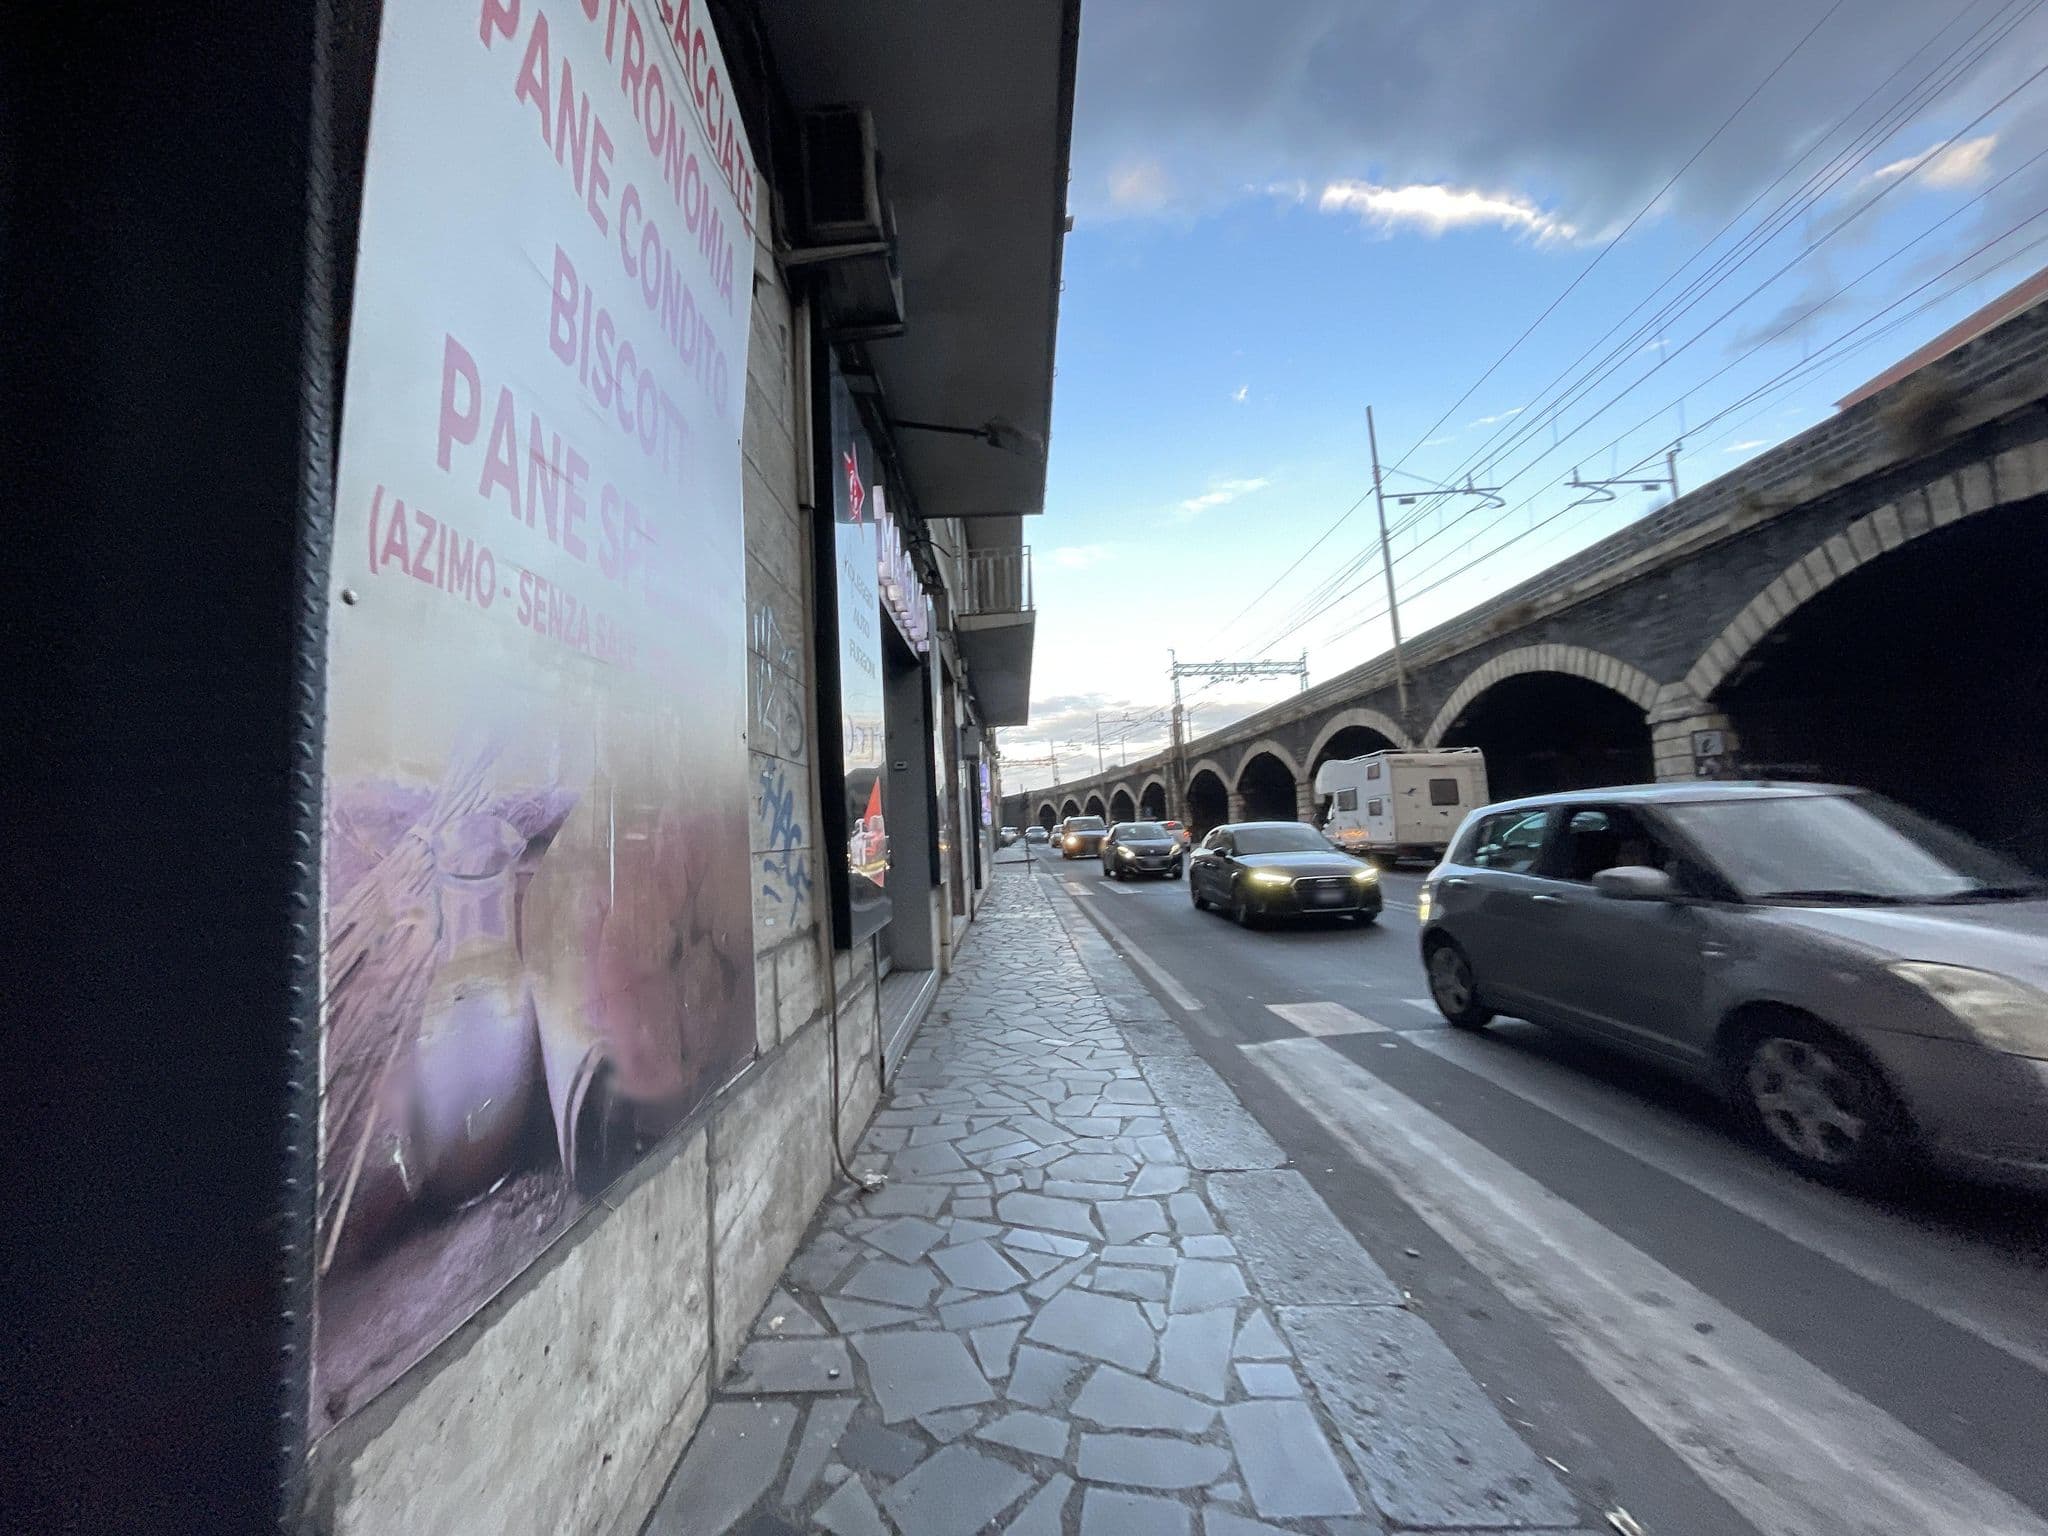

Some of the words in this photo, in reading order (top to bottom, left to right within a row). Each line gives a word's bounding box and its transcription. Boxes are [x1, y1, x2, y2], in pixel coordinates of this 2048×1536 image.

[579, 0, 733, 317] TRONOMIA
[550, 243, 697, 490] BISCOTT
[620, 183, 728, 417] CONDITO
[437, 333, 589, 562] PANE
[369, 484, 495, 608] (AZIMO
[517, 568, 590, 651] SENZA
